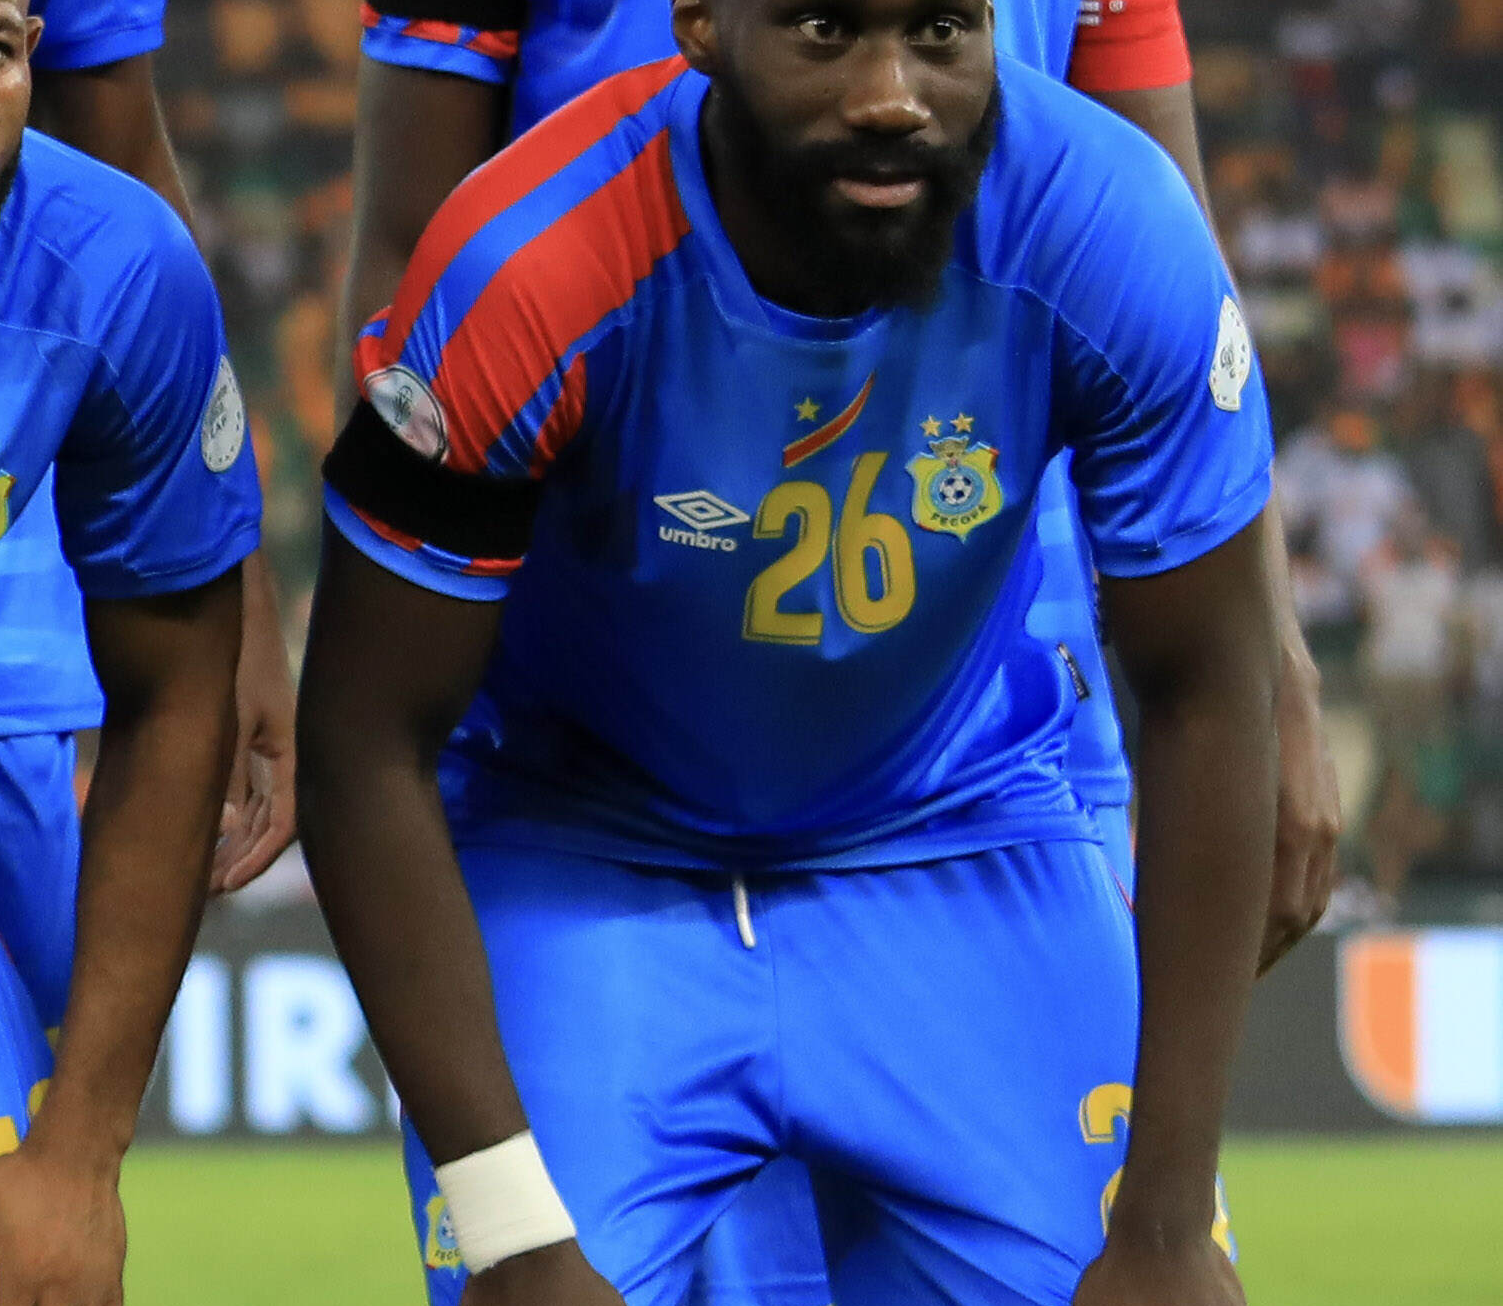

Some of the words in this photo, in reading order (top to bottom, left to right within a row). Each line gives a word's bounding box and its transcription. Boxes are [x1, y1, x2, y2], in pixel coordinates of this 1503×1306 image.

[931, 504, 989, 527] FECOFA
[657, 526, 738, 554] umbro
[741, 450, 917, 646] 26
